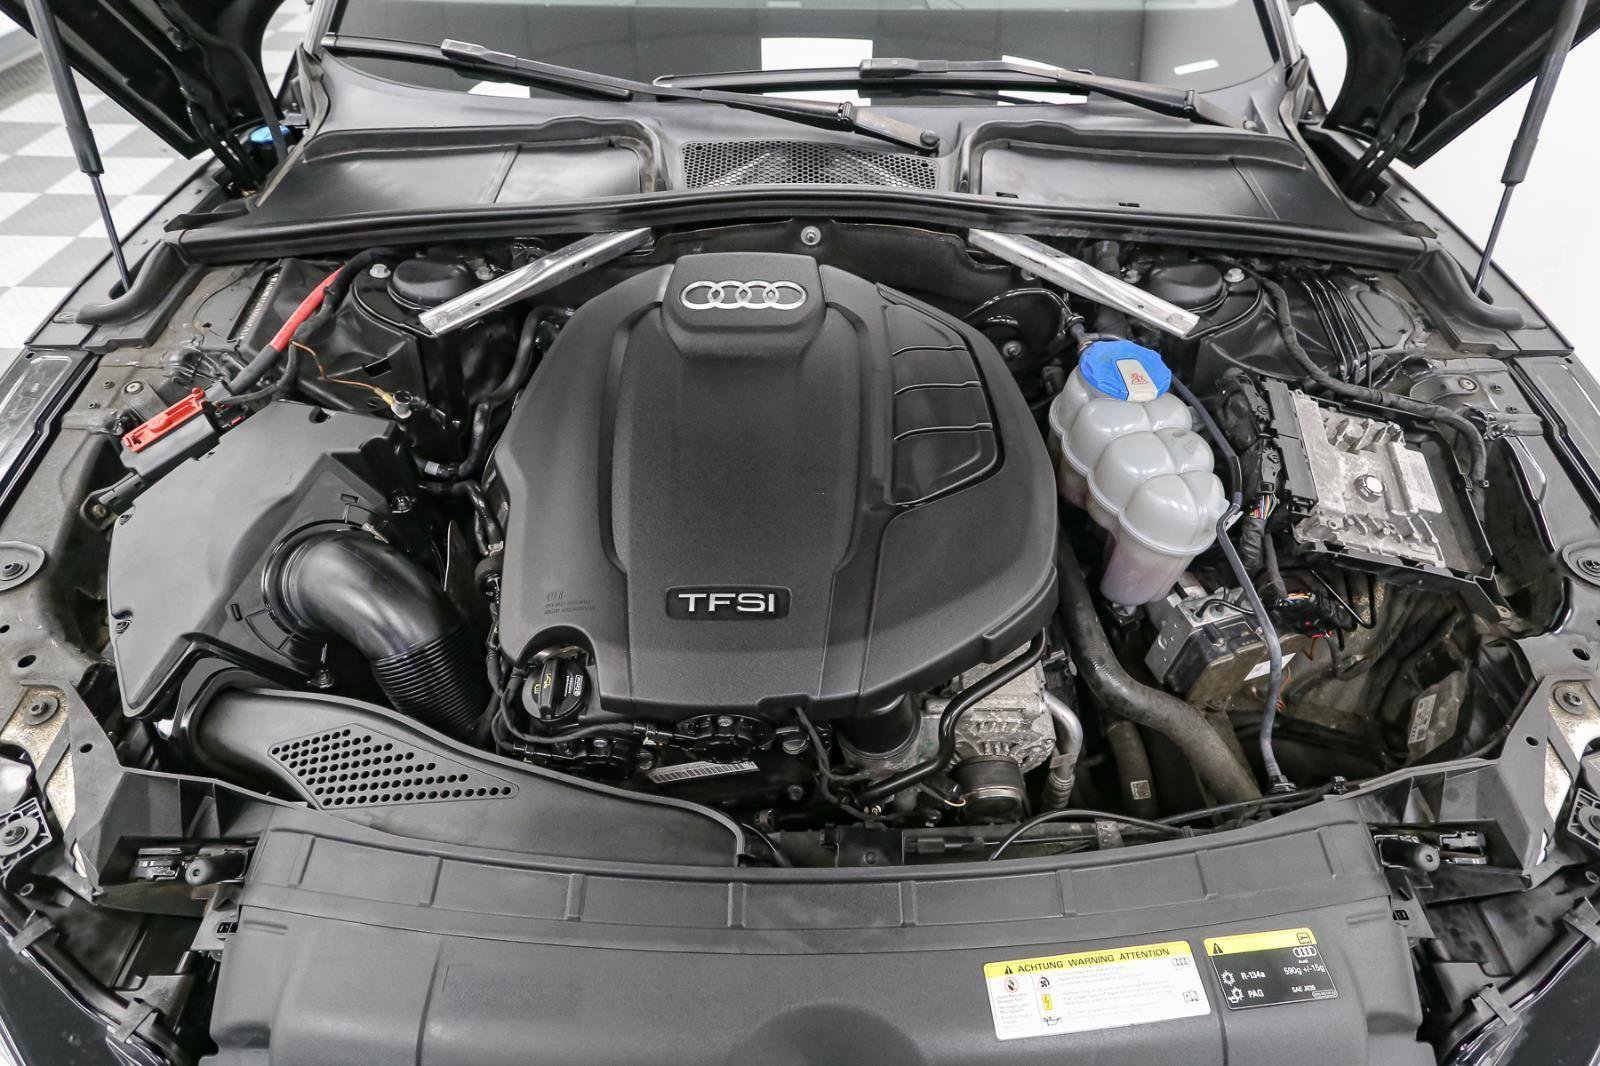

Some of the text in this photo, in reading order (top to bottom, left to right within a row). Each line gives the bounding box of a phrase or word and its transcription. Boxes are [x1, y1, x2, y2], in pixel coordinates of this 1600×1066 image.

[678, 593, 775, 612] TFSI
[1017, 960, 1064, 973] ACHTUNG
[1068, 954, 1115, 967] WARNING
[1119, 948, 1170, 961] ATTENTION
[1247, 988, 1265, 998] PAG
